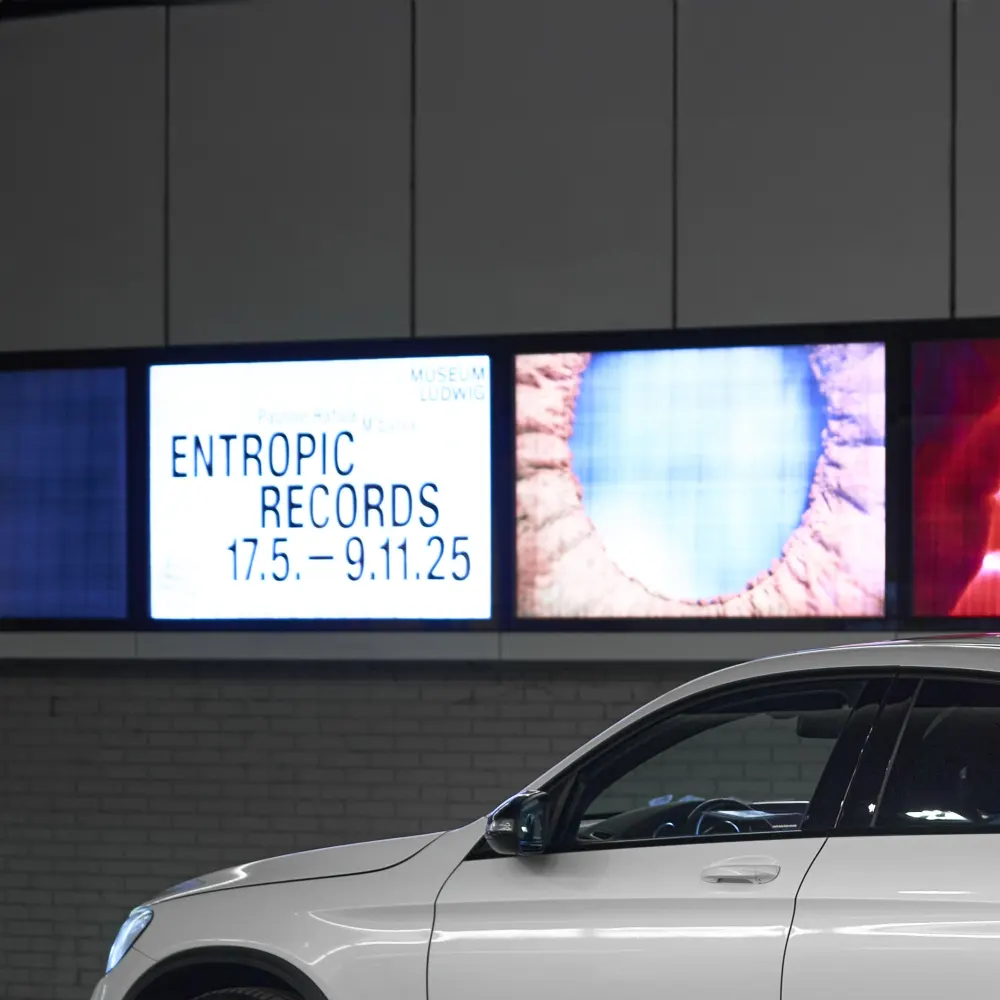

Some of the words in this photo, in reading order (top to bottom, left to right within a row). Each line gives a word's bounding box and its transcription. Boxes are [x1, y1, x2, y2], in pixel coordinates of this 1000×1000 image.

[411, 366, 485, 382] MUSEUM
[421, 385, 485, 401] LUDWIG
[172, 431, 354, 477] ENTROPIC
[261, 483, 439, 528] RECORDS
